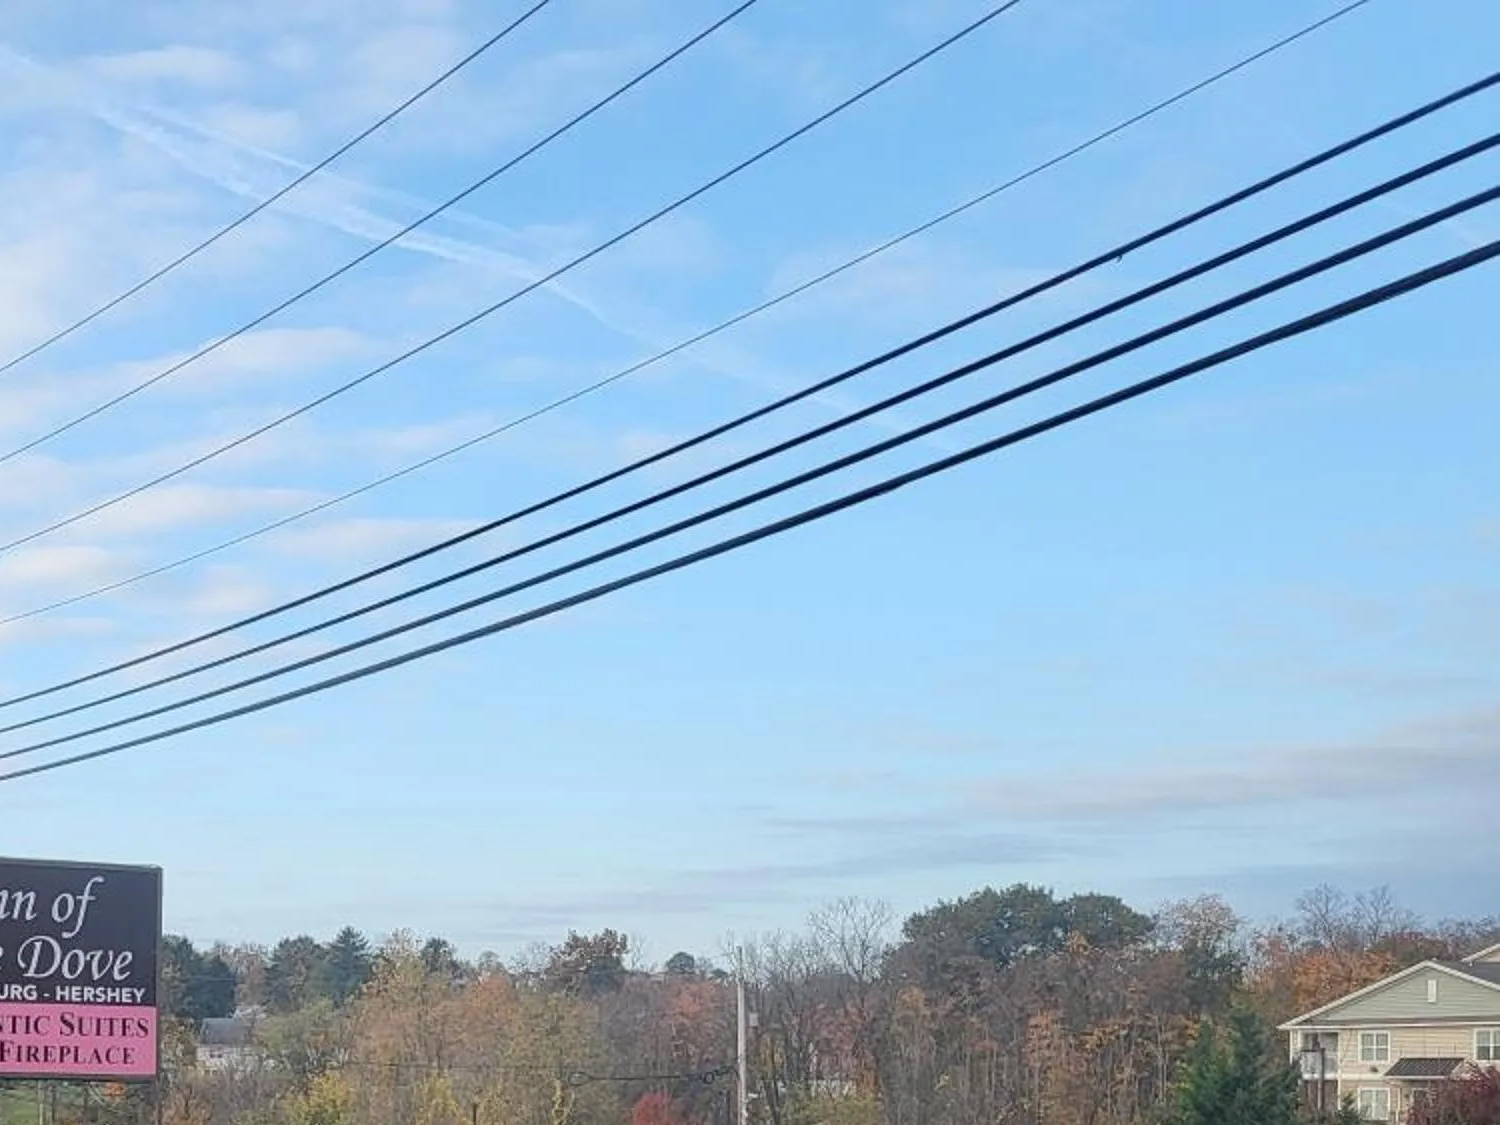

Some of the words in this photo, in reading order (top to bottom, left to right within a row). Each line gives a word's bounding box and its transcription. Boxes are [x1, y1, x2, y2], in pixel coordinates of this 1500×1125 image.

[52, 875, 104, 939] of
[17, 935, 133, 982] Dove
[55, 985, 146, 1003] HERSHEY
[59, 1012, 149, 1038] SUITES
